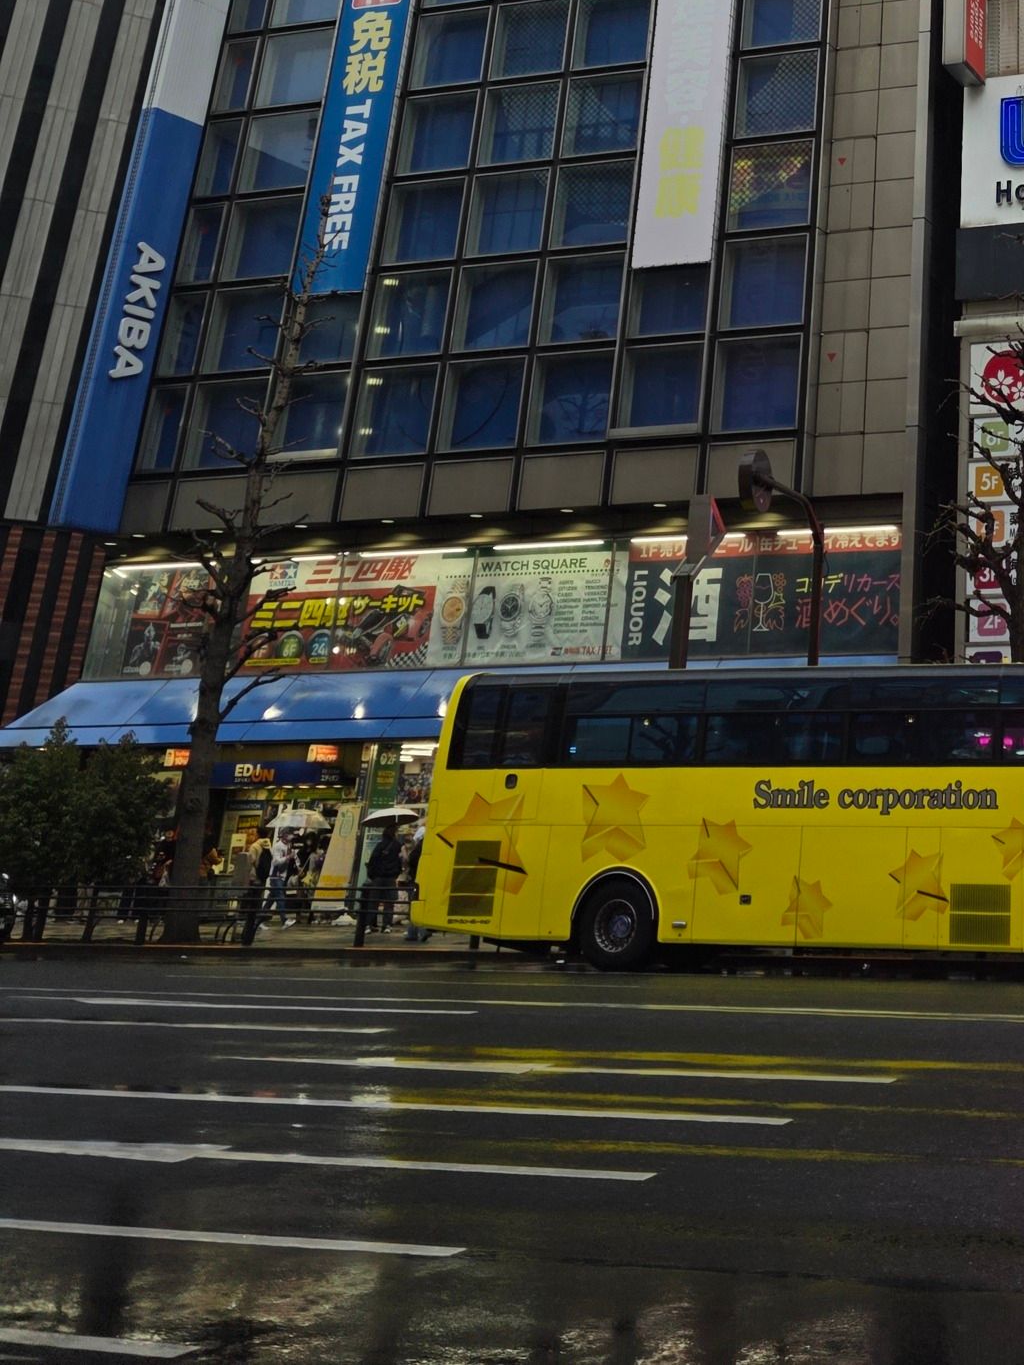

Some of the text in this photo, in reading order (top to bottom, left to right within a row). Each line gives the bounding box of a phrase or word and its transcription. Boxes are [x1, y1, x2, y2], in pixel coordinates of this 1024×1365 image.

[343, 11, 393, 96] 免税
[324, 99, 373, 252] TAX FREE
[108, 241, 166, 379] AKIBA
[981, 472, 999, 491] 5F
[305, 555, 419, 585] ミニ四駆
[481, 558, 588, 572] WATCH SQUARE
[628, 570, 649, 646] LIQUOR
[234, 763, 276, 782] EDION
[753, 780, 998, 815] Smile corporation
